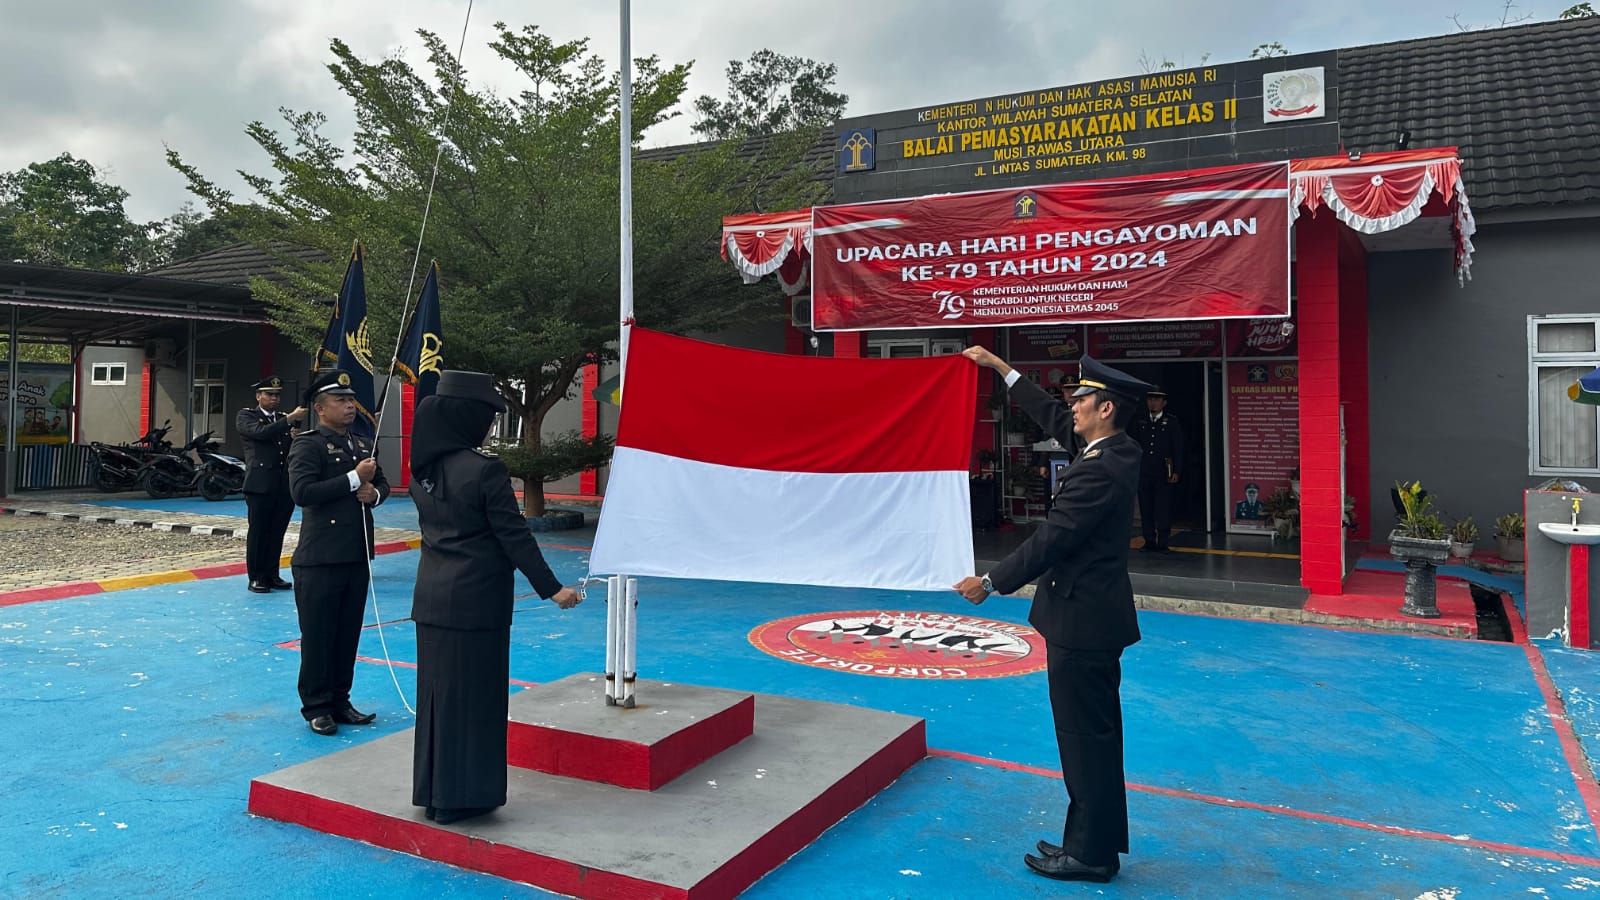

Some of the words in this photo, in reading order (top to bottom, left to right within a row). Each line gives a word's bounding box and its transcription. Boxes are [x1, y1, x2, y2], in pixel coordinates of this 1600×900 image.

[997, 95, 1035, 111] HUKUM
[1040, 90, 1063, 105] DAN
[1067, 85, 1092, 100] HAK
[1098, 81, 1135, 97] ASASI
[1140, 72, 1197, 91] MANUSIA
[1204, 69, 1217, 82] RI
[938, 117, 986, 133] KANTOR
[992, 109, 1047, 126] WILAYAH
[1052, 97, 1123, 118] SUMATERA
[1130, 88, 1193, 107] SELATAN
[903, 135, 954, 158] BALAI
[961, 110, 1136, 152] PEMASYARAKATAN
[1146, 101, 1215, 129] KELAS
[1224, 98, 1237, 120] II
[974, 166, 987, 177] JL
[992, 161, 1030, 175] LINTAS
[1035, 153, 1101, 170] SUMATERA
[1106, 150, 1128, 162] KM.
[1132, 148, 1146, 159] 98
[994, 145, 1023, 161] MUSI
[1029, 140, 1073, 157] RAWAS
[1080, 135, 1125, 151] UTARA
[836, 241, 954, 263] UPACARA
[961, 235, 1026, 255] HARI
[1035, 217, 1257, 250] PENGAYOMAN
[902, 262, 978, 282] KE-79
[985, 256, 1081, 277] TAHUN
[1091, 250, 1168, 271] 2024
[973, 284, 1040, 296] KEMENTERIAN
[1041, 283, 1077, 293] HUKUM
[1078, 281, 1100, 291] DAN
[1102, 281, 1128, 289] HAM
[973, 297, 1023, 306] MENGABDI
[1024, 295, 1057, 304] UNTUK
[1058, 293, 1094, 302] NEGERI
[973, 307, 1011, 316] MENUJU
[1012, 305, 1063, 316] INDONESIA
[1065, 304, 1093, 313] EMAS
[1094, 302, 1119, 312] 2045
[18, 382, 45, 396] Anak
[778, 648, 968, 677] CORPORATE
